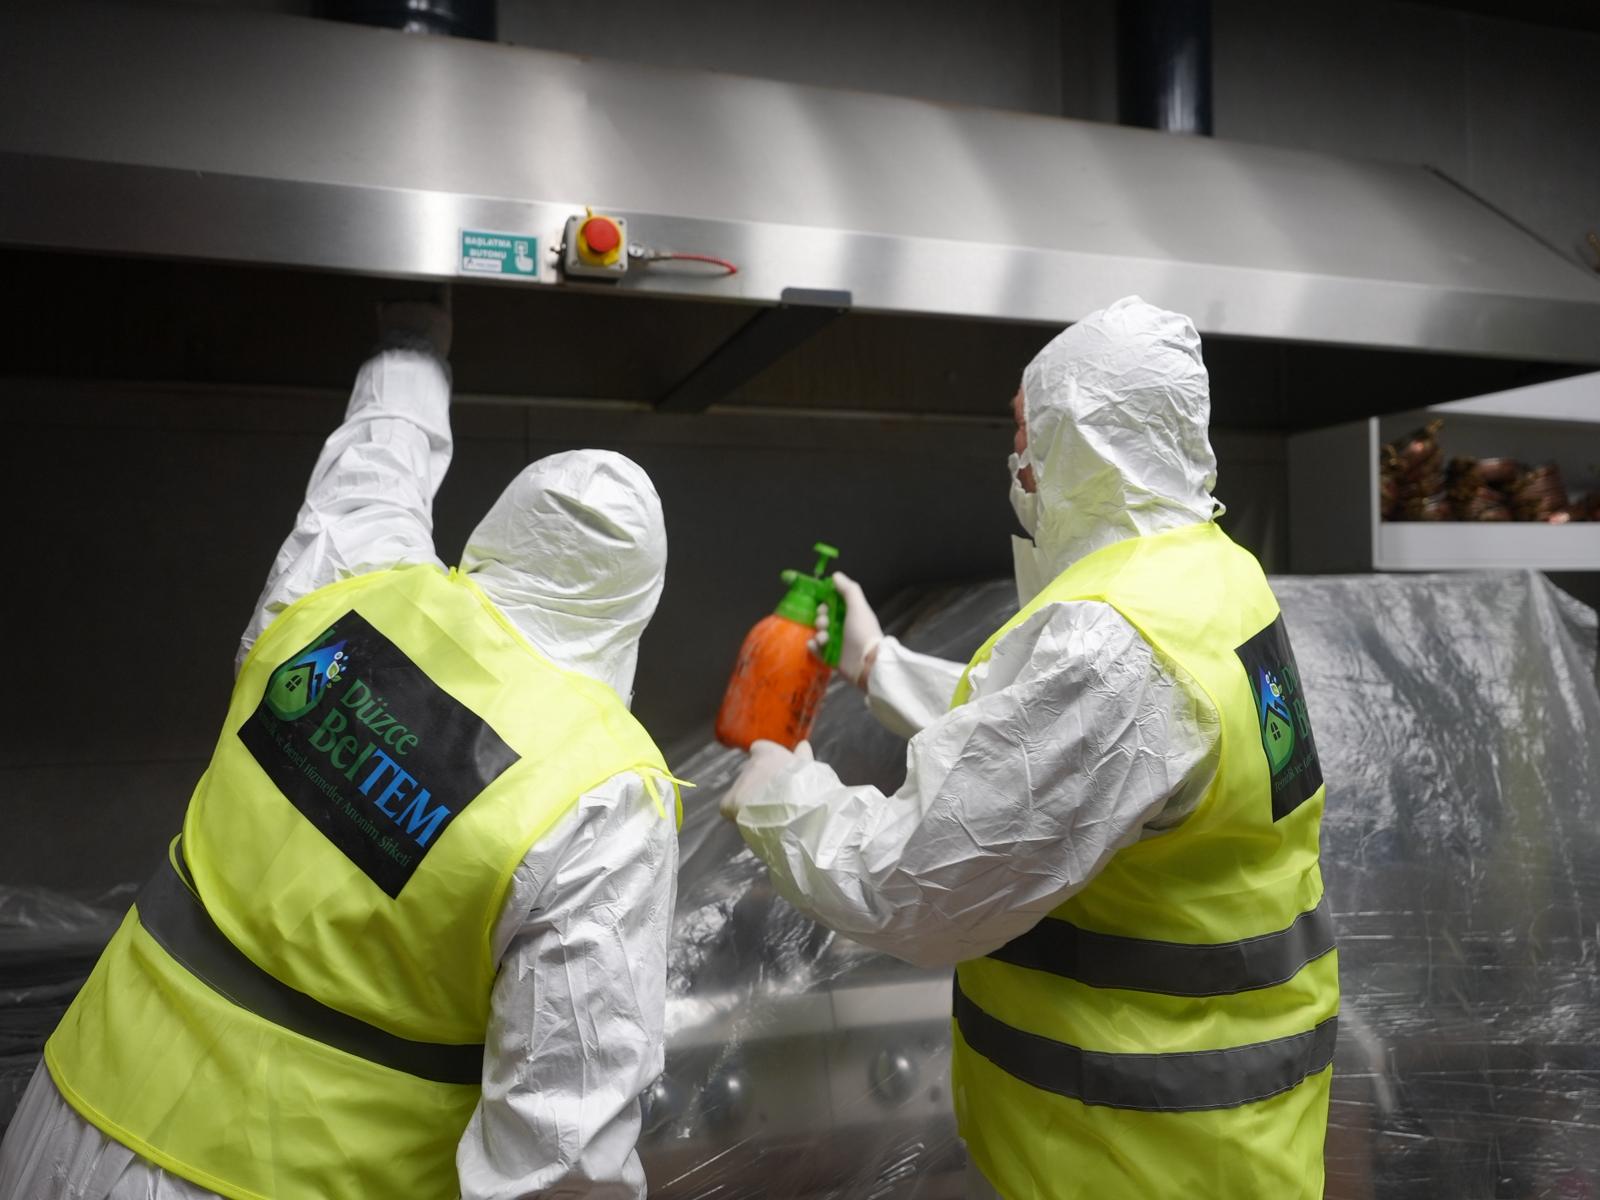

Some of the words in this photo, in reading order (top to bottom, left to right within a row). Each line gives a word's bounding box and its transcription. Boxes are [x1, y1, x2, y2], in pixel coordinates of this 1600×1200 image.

[340, 678, 419, 755] Düzce
[308, 707, 452, 848] BelTEM
[343, 800, 380, 840] Anonim
